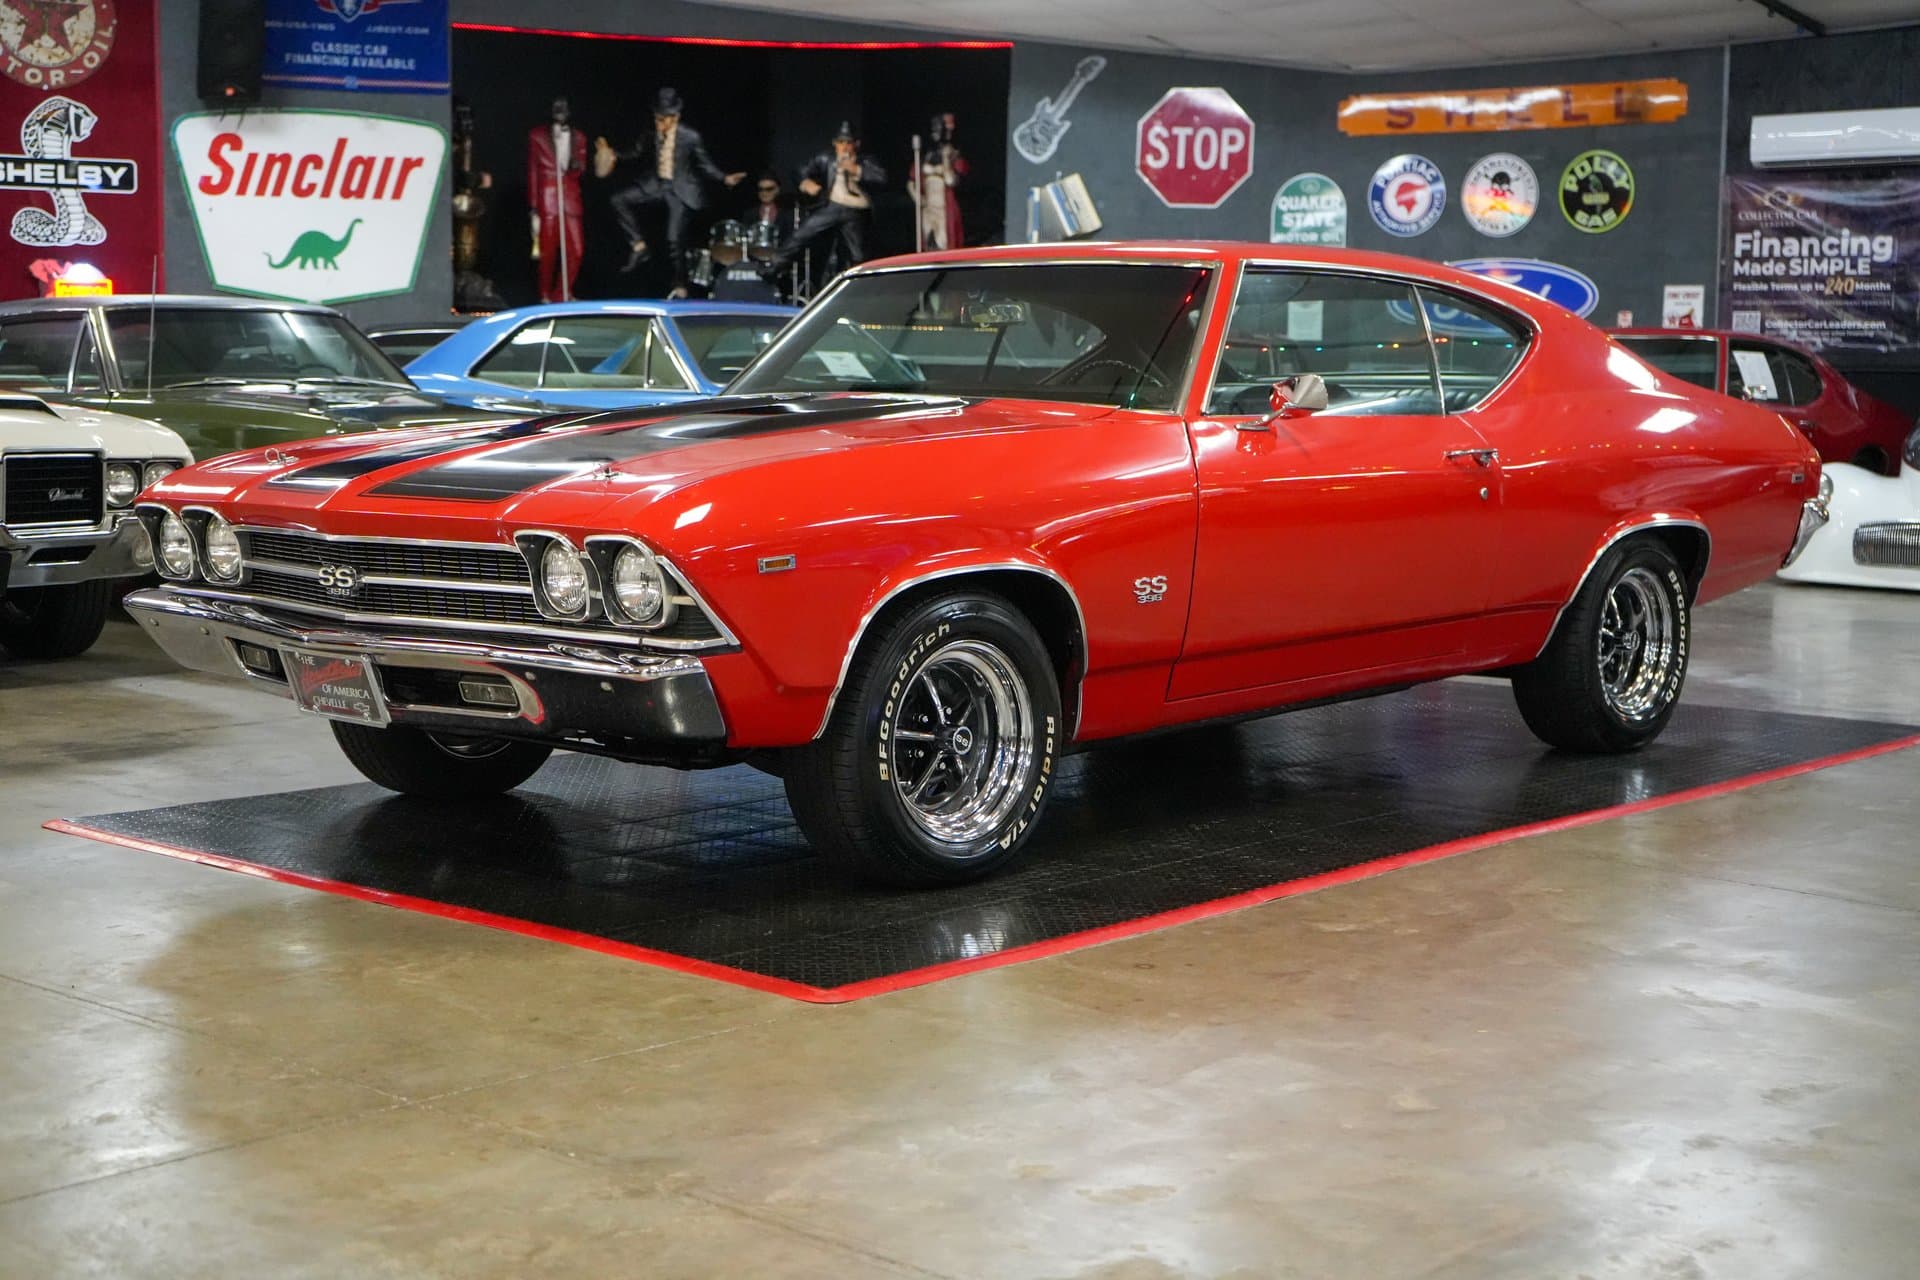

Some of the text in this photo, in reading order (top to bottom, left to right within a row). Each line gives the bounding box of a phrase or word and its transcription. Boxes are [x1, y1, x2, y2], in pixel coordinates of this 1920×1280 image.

[311, 42, 388, 56] CLASSIC CAR
[285, 53, 416, 70] FINANCING AVAILABLE
[1386, 87, 1642, 129] SHELL
[1146, 124, 1245, 170] STOP
[199, 133, 424, 201] Sinclair
[1565, 156, 1629, 192] POLLY
[1279, 196, 1342, 211] QUAKER
[1282, 212, 1337, 229] STATE
[1575, 208, 1617, 227] GAS
[1734, 229, 1893, 263] Financing
[1733, 257, 1871, 276] Made SIMPLE
[1733, 276, 1891, 295] Flexible Terms up to 240 Months
[1764, 320, 1886, 330] CollectorCarLeaders.com
[319, 566, 354, 587] SS
[1133, 575, 1168, 595] SS
[1137, 594, 1163, 604] 396
[1665, 569, 1686, 704] BFGoodrich
[300, 655, 315, 665] THE
[322, 683, 370, 699] OF AMERICA
[312, 695, 347, 708] CHEVELLE
[878, 624, 950, 781] BFGoodrich
[1000, 715, 1055, 851] Radial T/A
